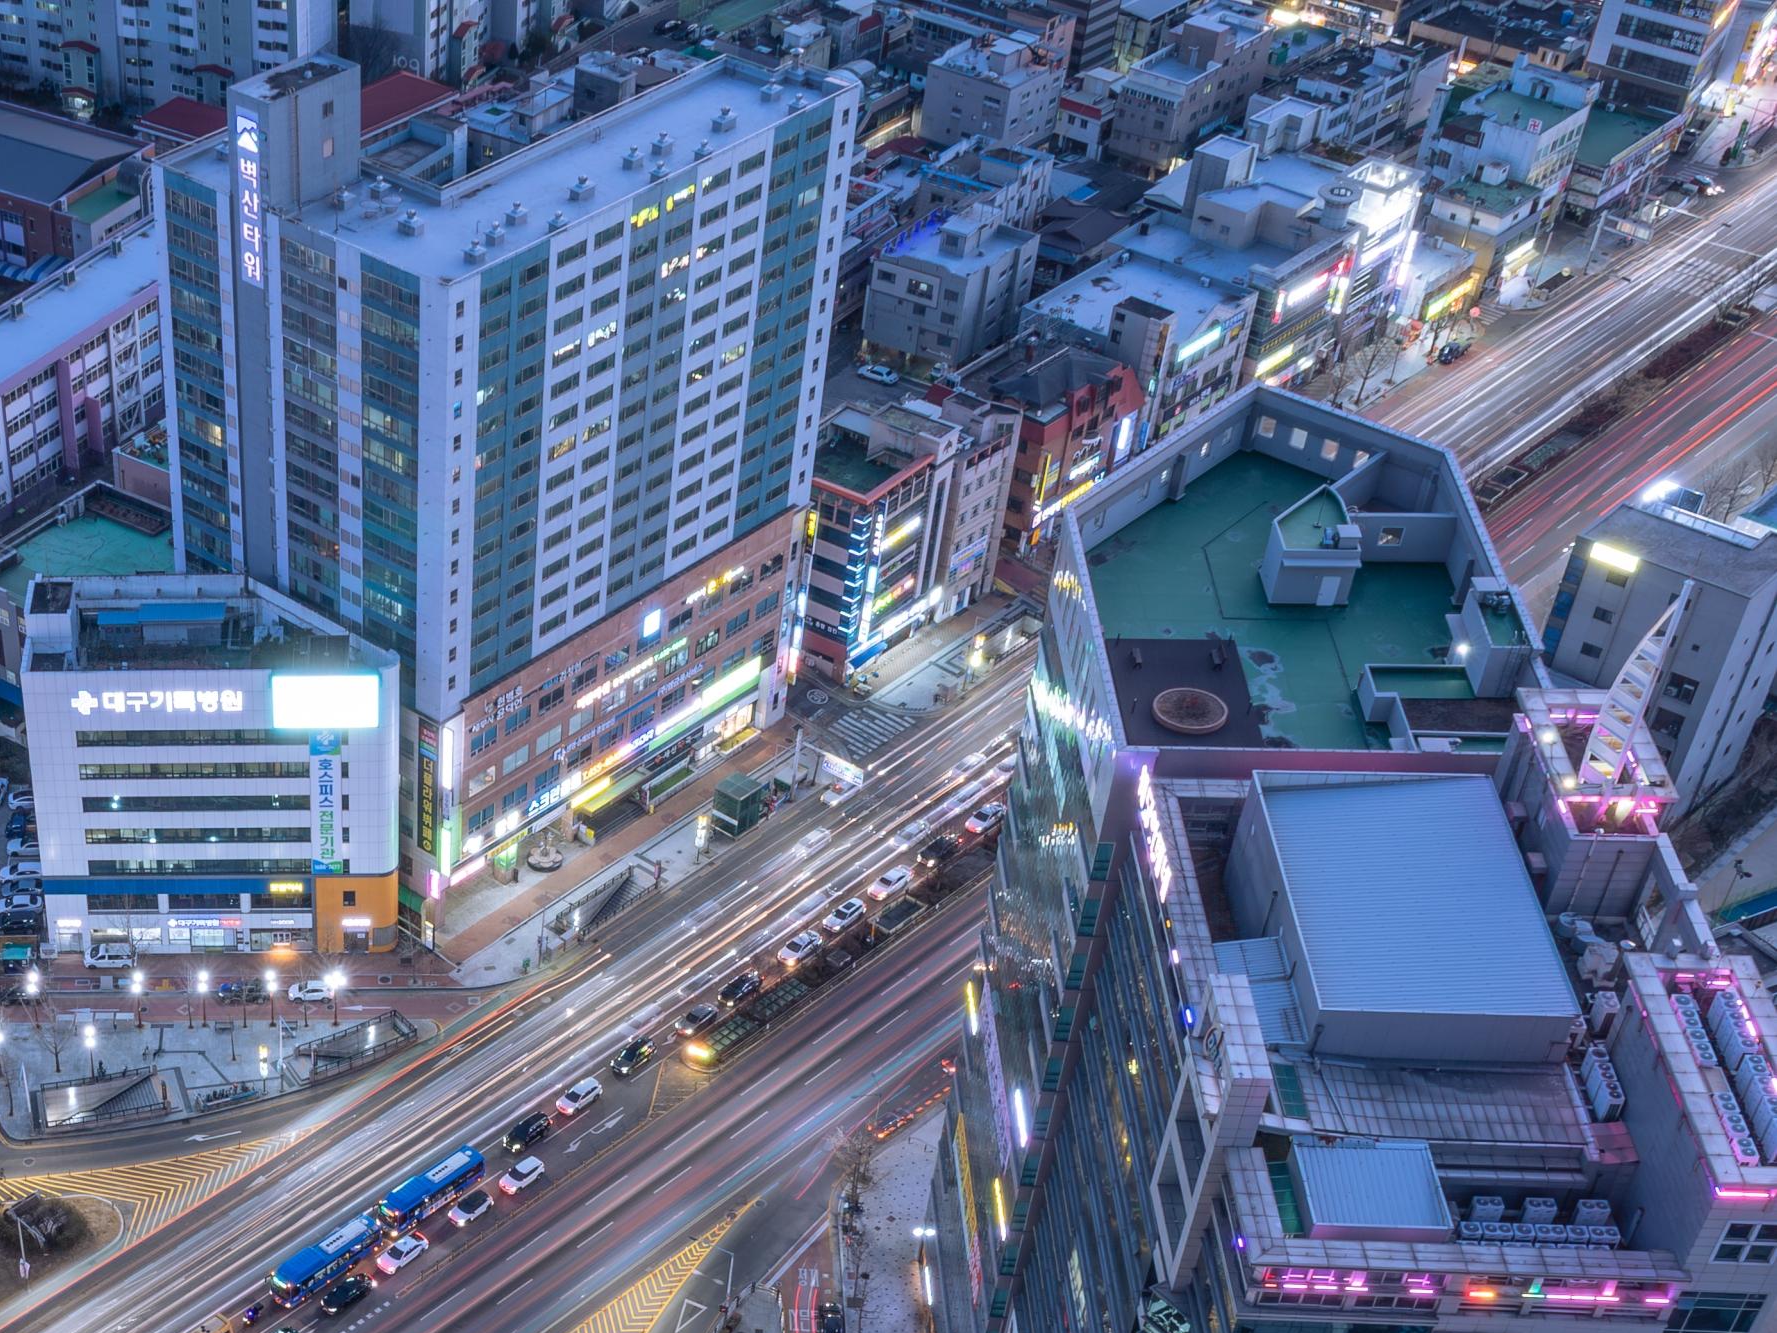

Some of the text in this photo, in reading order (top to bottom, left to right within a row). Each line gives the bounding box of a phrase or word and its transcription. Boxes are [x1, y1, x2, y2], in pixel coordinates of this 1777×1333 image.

[240, 158, 261, 282] 벽산타워
[318, 758, 335, 861] 호스피스 전문기관
